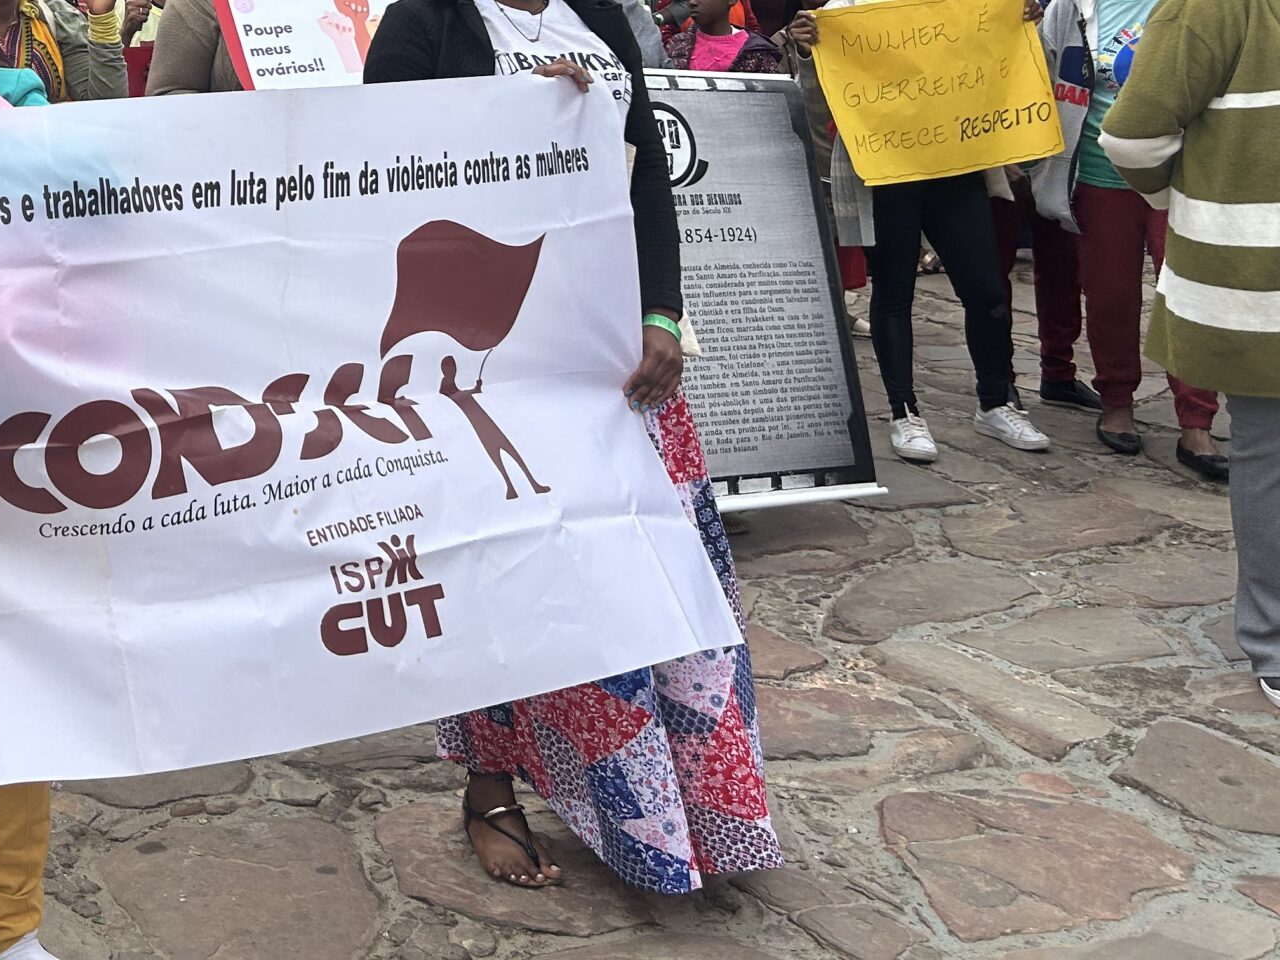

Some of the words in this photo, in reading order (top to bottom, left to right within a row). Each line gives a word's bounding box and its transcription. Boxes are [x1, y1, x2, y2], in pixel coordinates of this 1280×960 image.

[242, 24, 293, 38] Poupe
[840, 22, 960, 57] MULHER
[250, 44, 292, 57] meus
[256, 57, 326, 77] ovários!!
[842, 66, 986, 108] GUERREIRA
[853, 124, 948, 155] MERECE
[21, 193, 35, 222] e
[42, 176, 183, 220] trabalhadores
[191, 181, 222, 209] em
[230, 168, 267, 206] luta
[275, 163, 315, 211] pelo
[322, 160, 351, 199] fim
[358, 160, 380, 197] da
[386, 151, 458, 194] violência
[463, 150, 511, 186] contra
[515, 155, 531, 180] as
[536, 141, 590, 178] mulheres
[679, 226, 758, 244] 854-1924)
[39, 513, 137, 540] Crescendo
[142, 516, 155, 531] a
[160, 499, 207, 530] cada
[214, 492, 257, 517] luta.
[263, 475, 318, 507] Maior
[322, 474, 334, 488] a
[336, 463, 374, 485] cada
[376, 450, 449, 480] Conquista.
[306, 514, 377, 548] ENTIDADE
[377, 503, 424, 531] FILIADA
[320, 583, 445, 657] CUT
